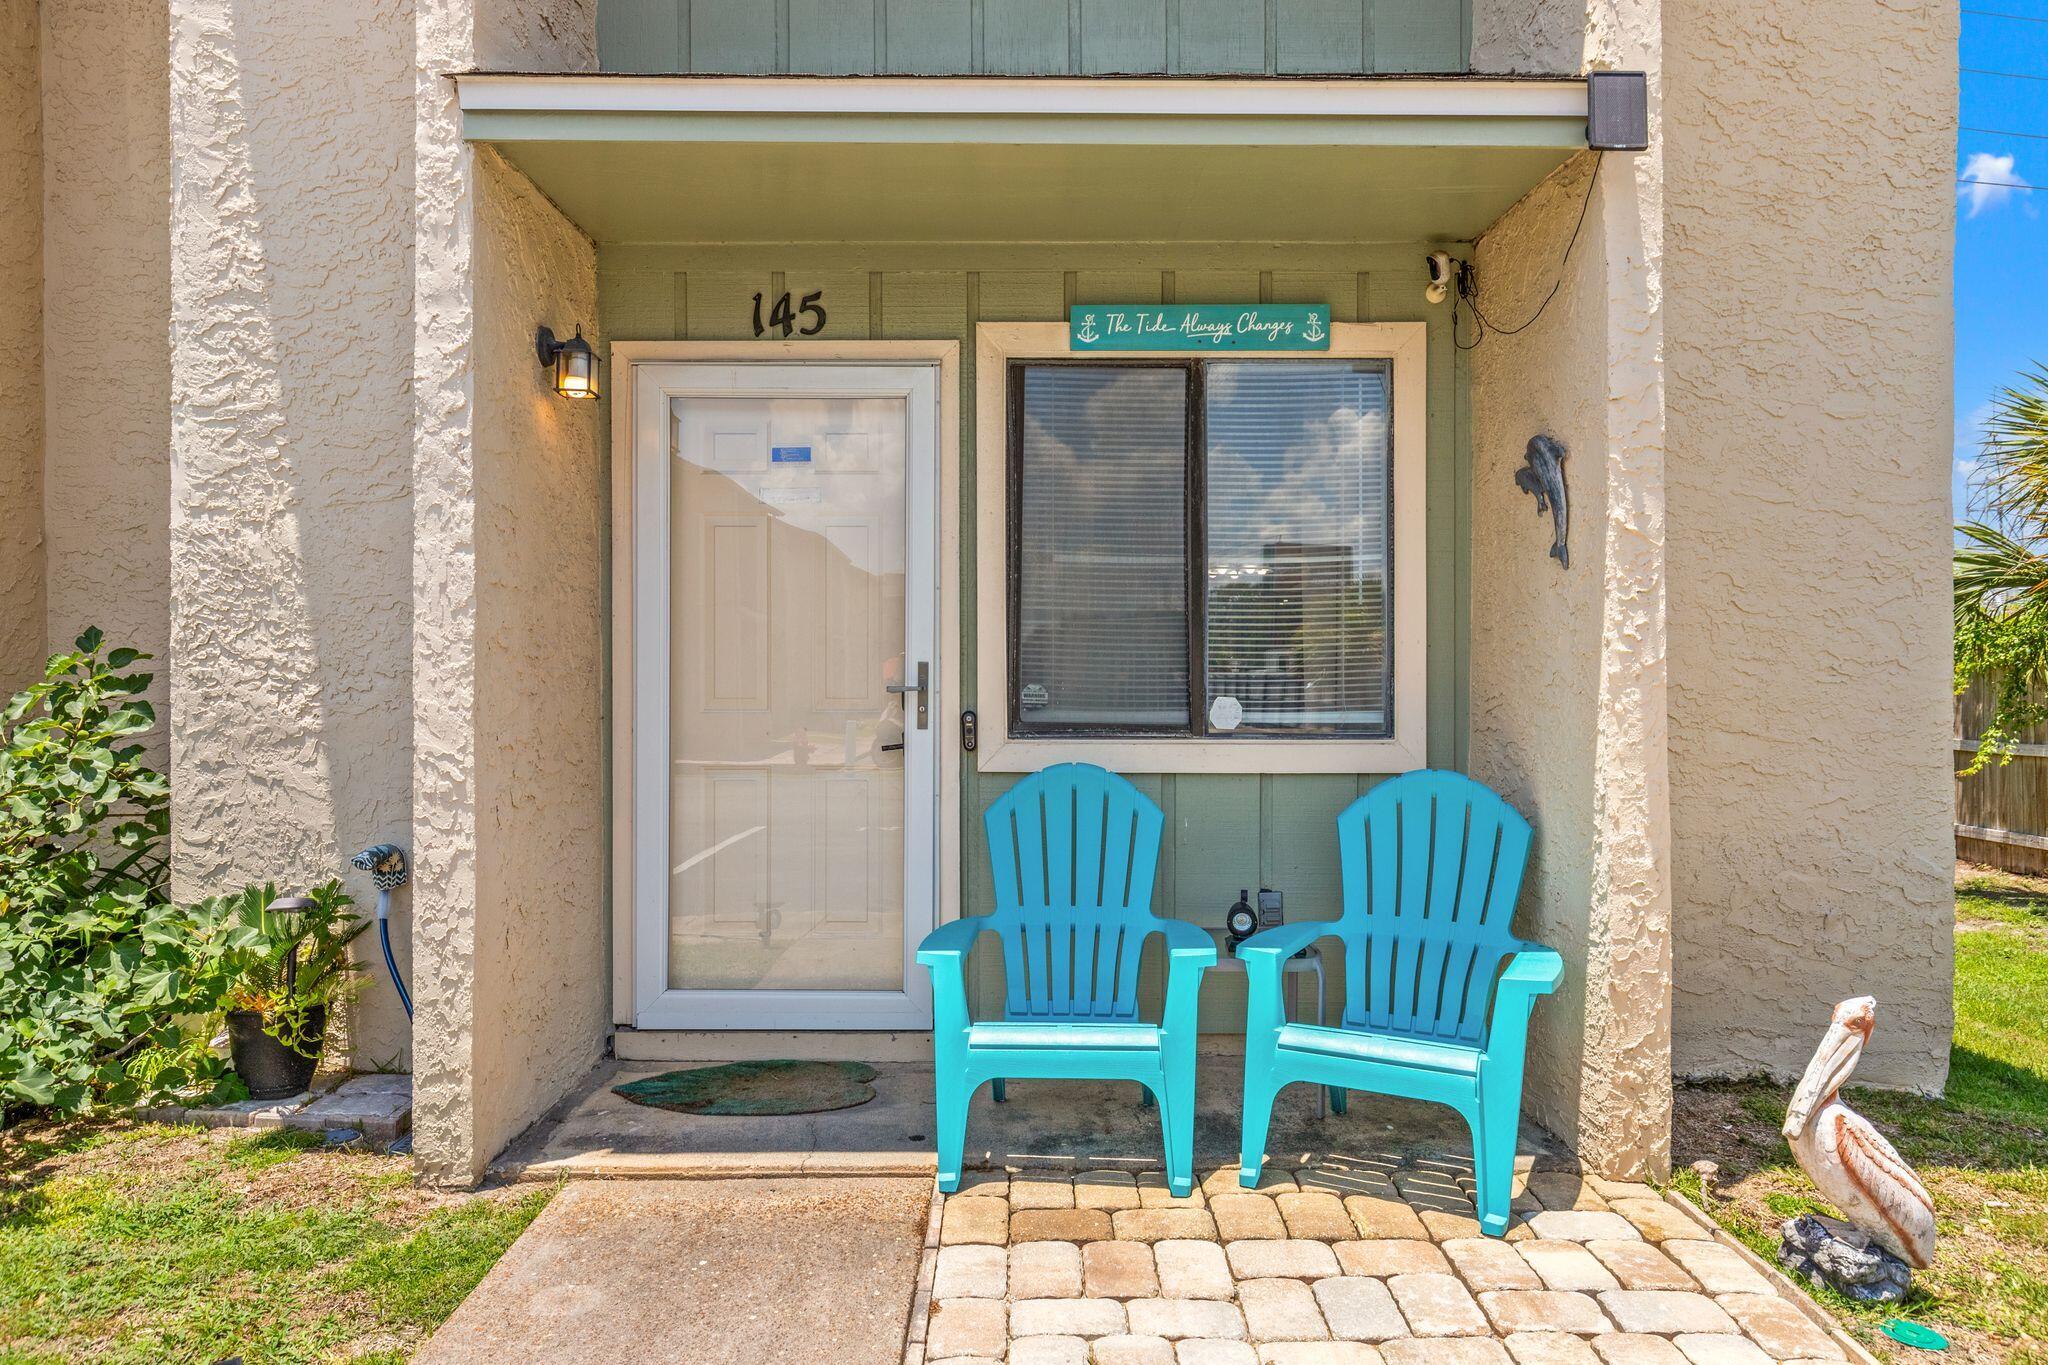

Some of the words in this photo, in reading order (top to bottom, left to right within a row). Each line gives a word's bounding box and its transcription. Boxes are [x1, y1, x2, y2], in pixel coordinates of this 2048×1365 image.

[752, 291, 826, 337] 145
[1106, 313, 1132, 335] The
[1136, 313, 1176, 334] Tide
[1180, 313, 1232, 343] Always
[1236, 312, 1294, 341] Changes
